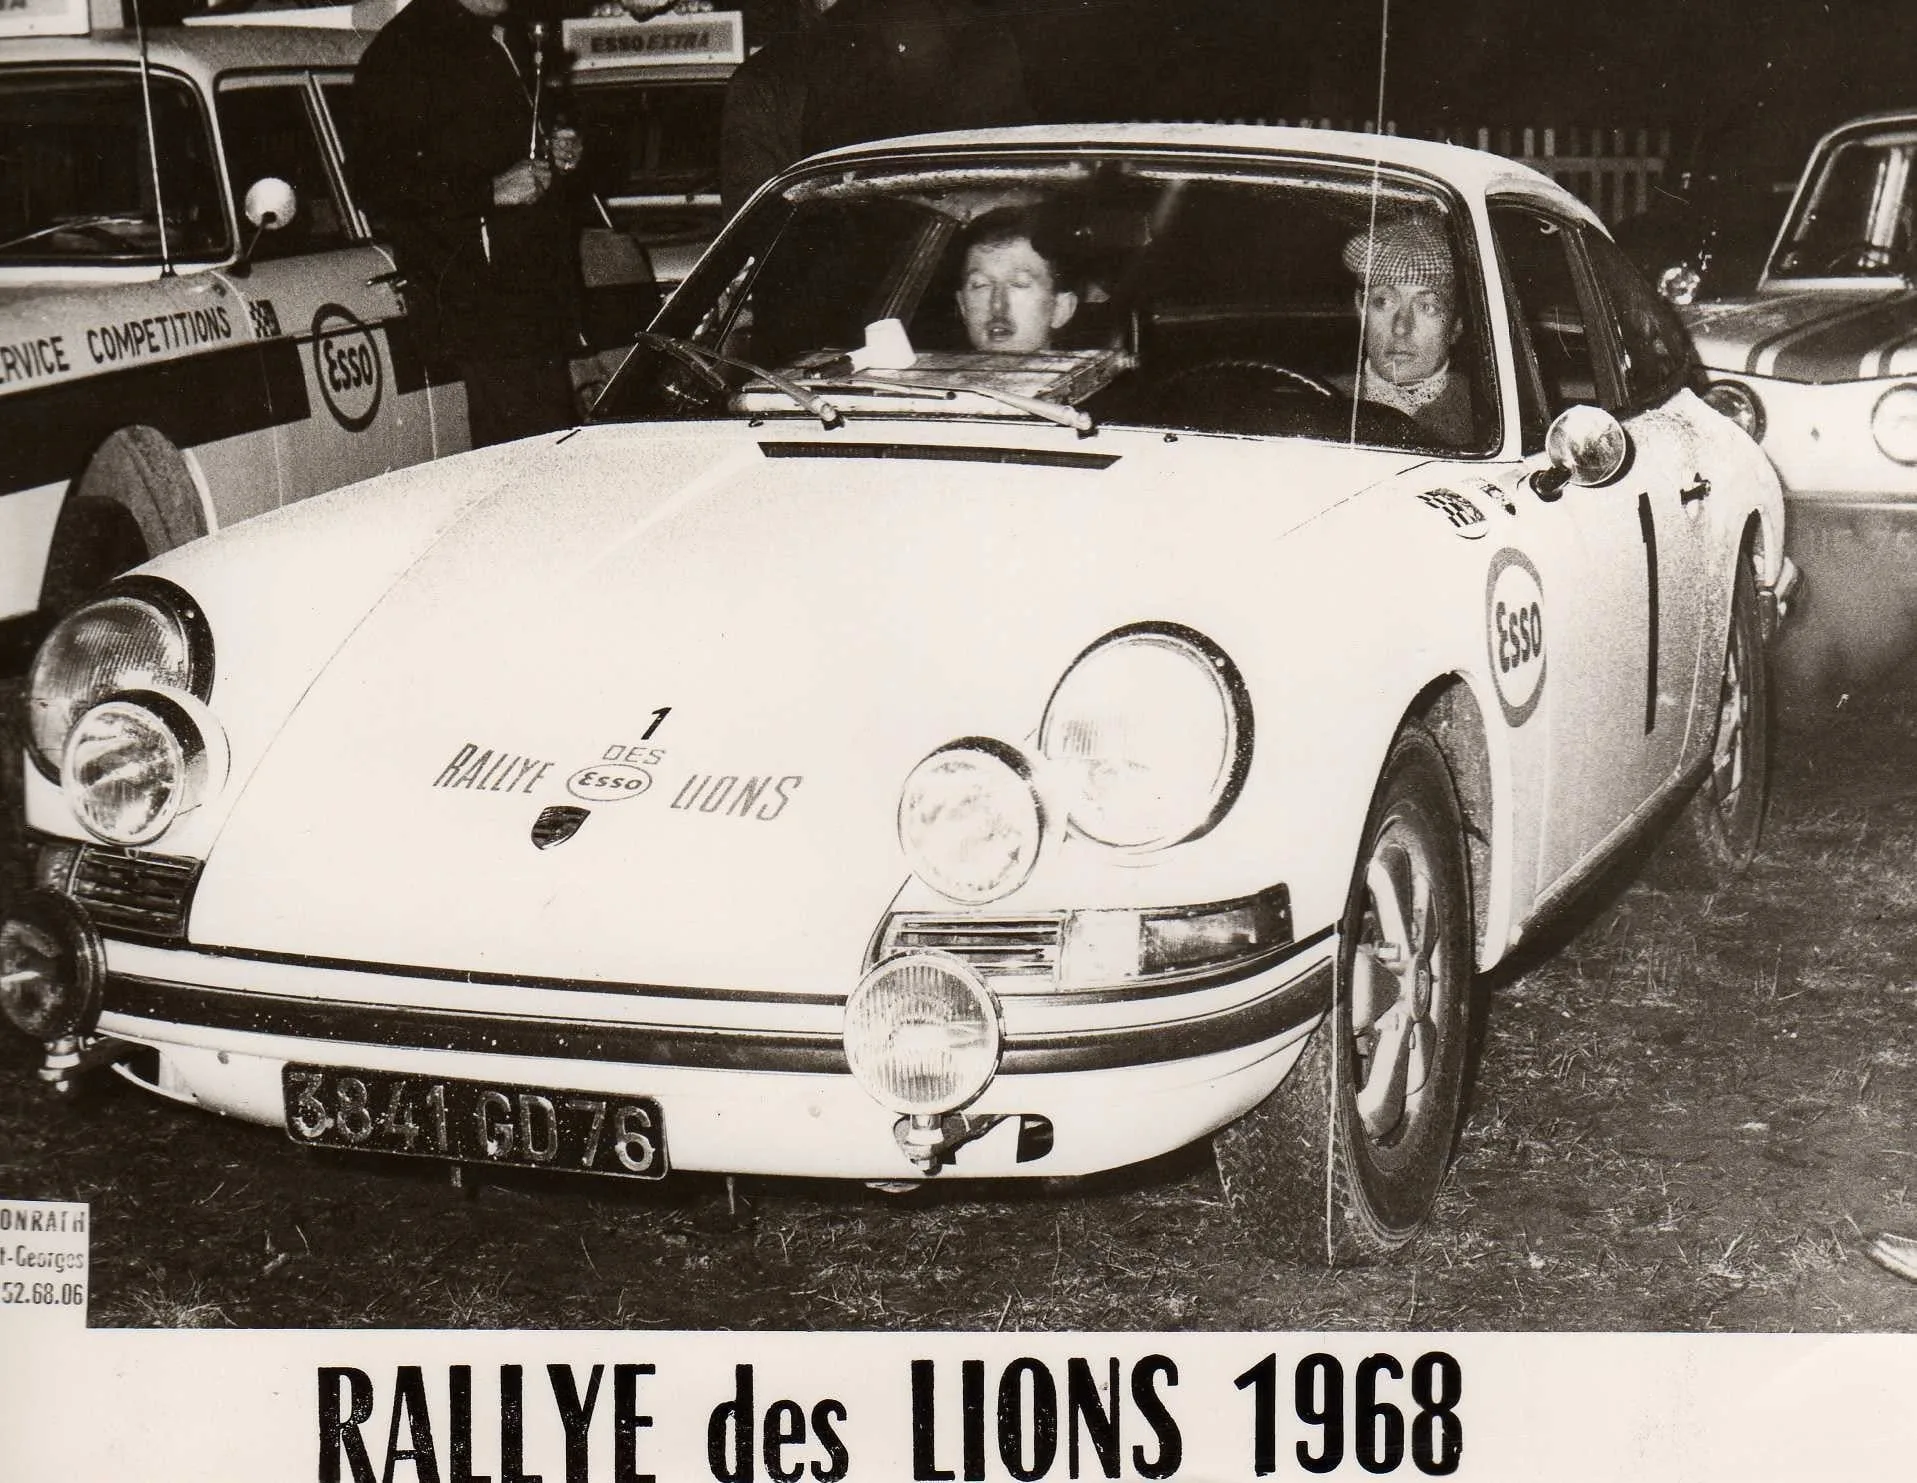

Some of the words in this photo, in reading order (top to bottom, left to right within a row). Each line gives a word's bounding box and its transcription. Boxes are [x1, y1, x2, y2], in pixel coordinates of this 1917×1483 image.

[0, 336, 70, 384] RVICE
[86, 306, 232, 364] COMPETITIONS
[641, 706, 672, 741] 1
[432, 743, 555, 794] RALLYE
[601, 744, 667, 765] DES
[670, 774, 803, 822] LIONS
[288, 1072, 449, 1153] 3841
[478, 1090, 558, 1163] GD
[568, 1098, 656, 1172] 76
